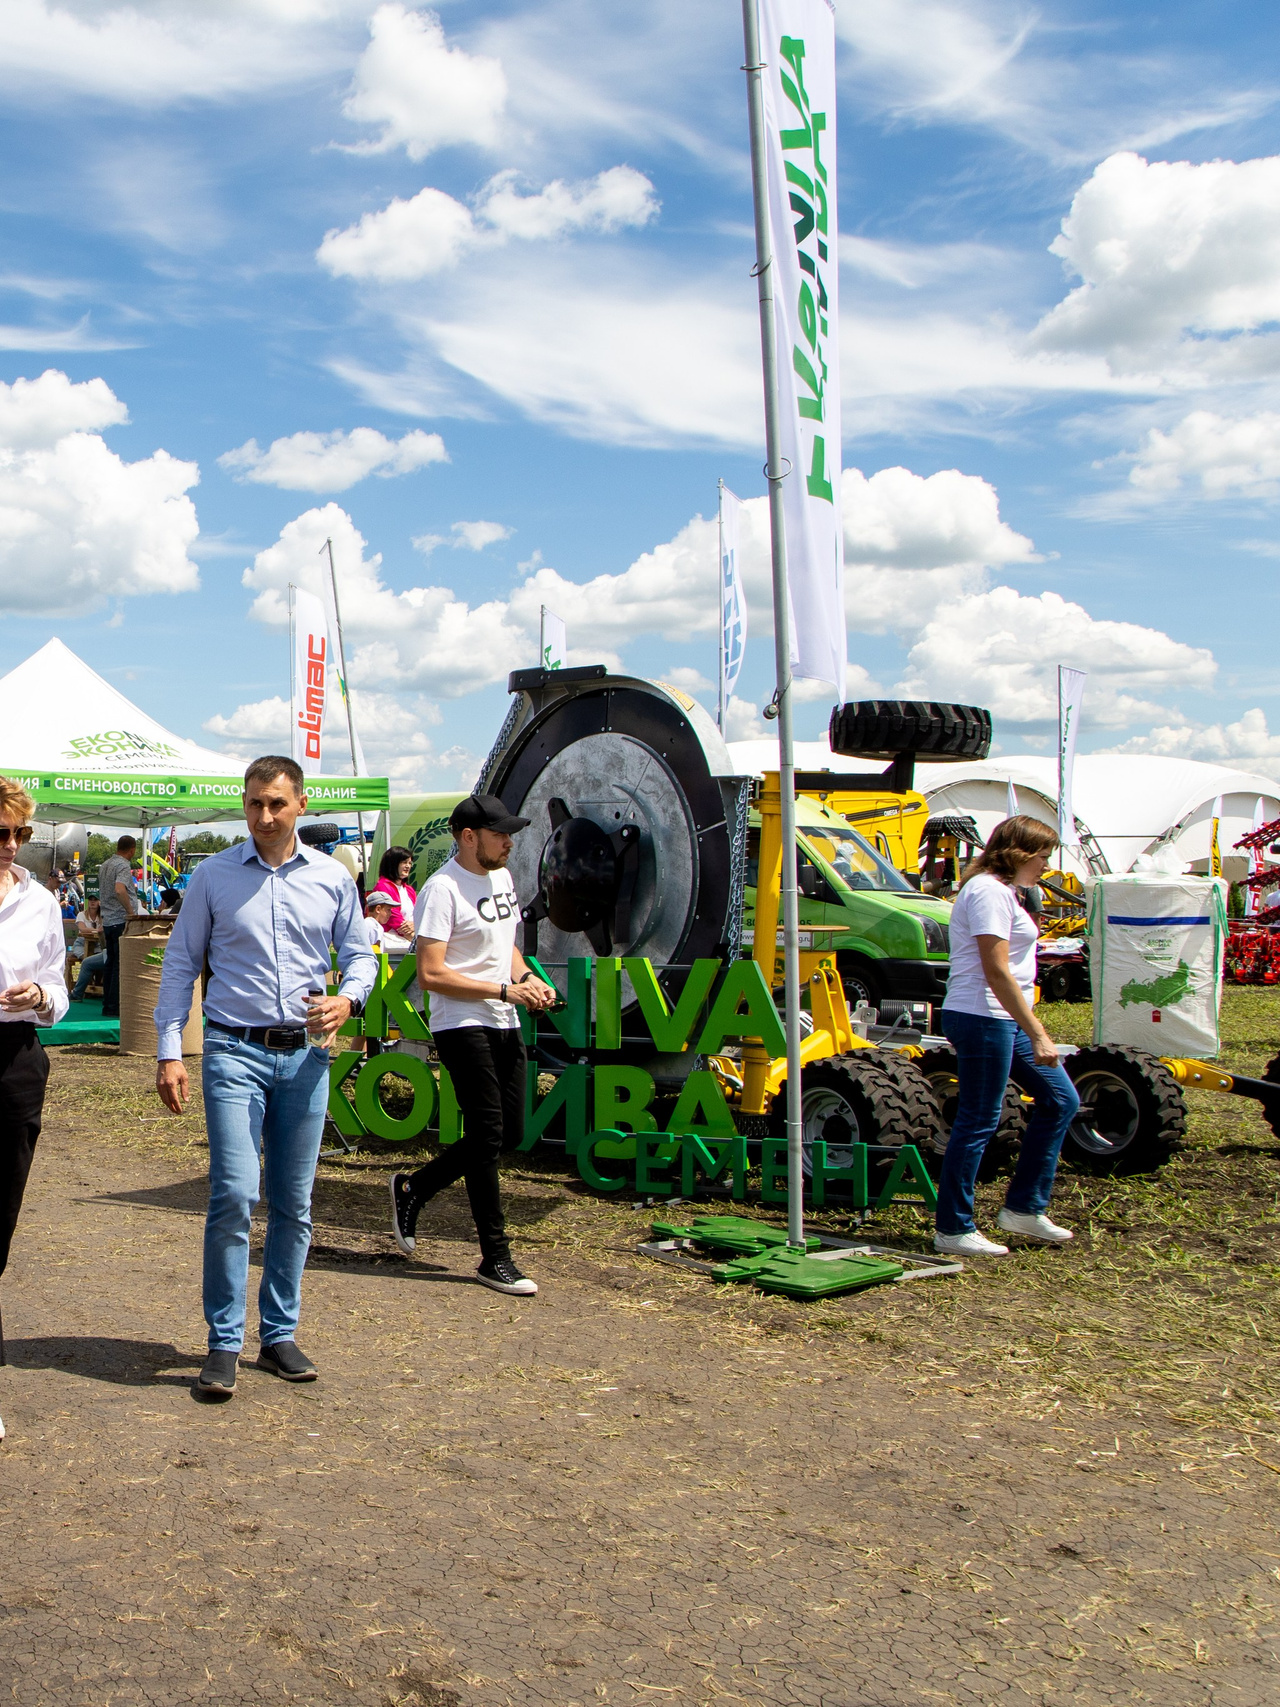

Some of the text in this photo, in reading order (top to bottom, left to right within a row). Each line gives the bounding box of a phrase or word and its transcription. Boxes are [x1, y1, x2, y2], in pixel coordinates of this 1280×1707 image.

[298, 633, 326, 760] olimac
[60, 740, 184, 760] ЭКОНИВА
[69, 730, 181, 753] EKONIVA
[104, 751, 169, 762] СЕМЕНА
[54, 777, 177, 796] СЕМЕНОВОДСТВО
[576, 1129, 939, 1212] СЕМЕНА
